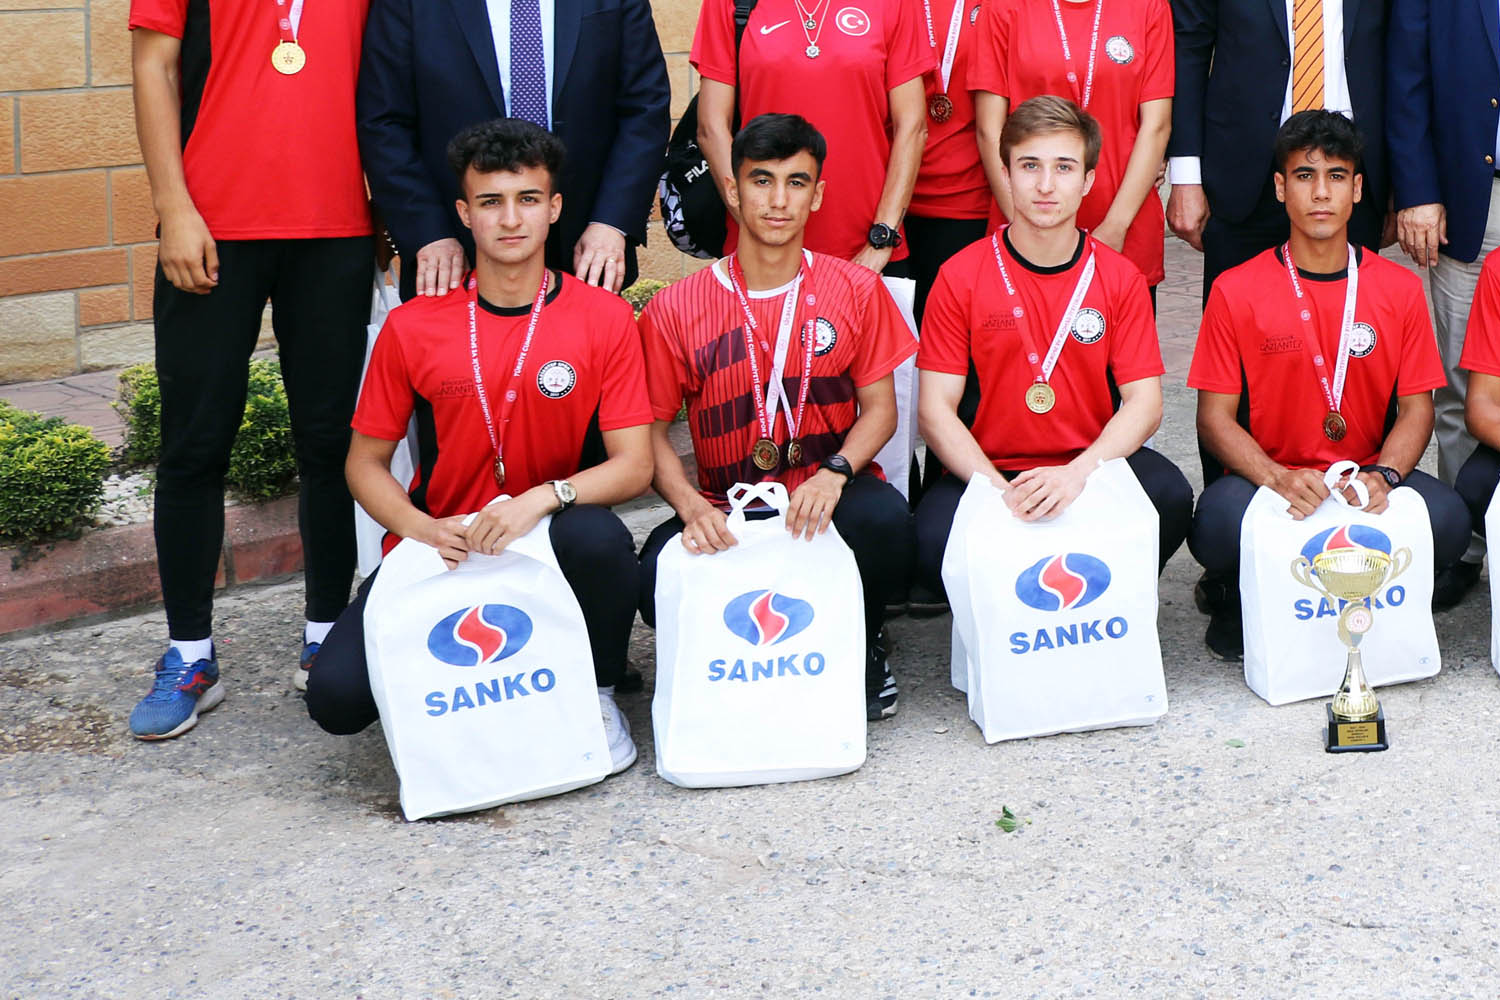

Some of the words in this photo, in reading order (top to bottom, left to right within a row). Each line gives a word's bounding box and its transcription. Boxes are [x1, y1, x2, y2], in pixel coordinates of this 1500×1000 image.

[1009, 616, 1129, 655] SANKO
[708, 652, 826, 683] SANKO
[424, 668, 557, 717] SANKO
